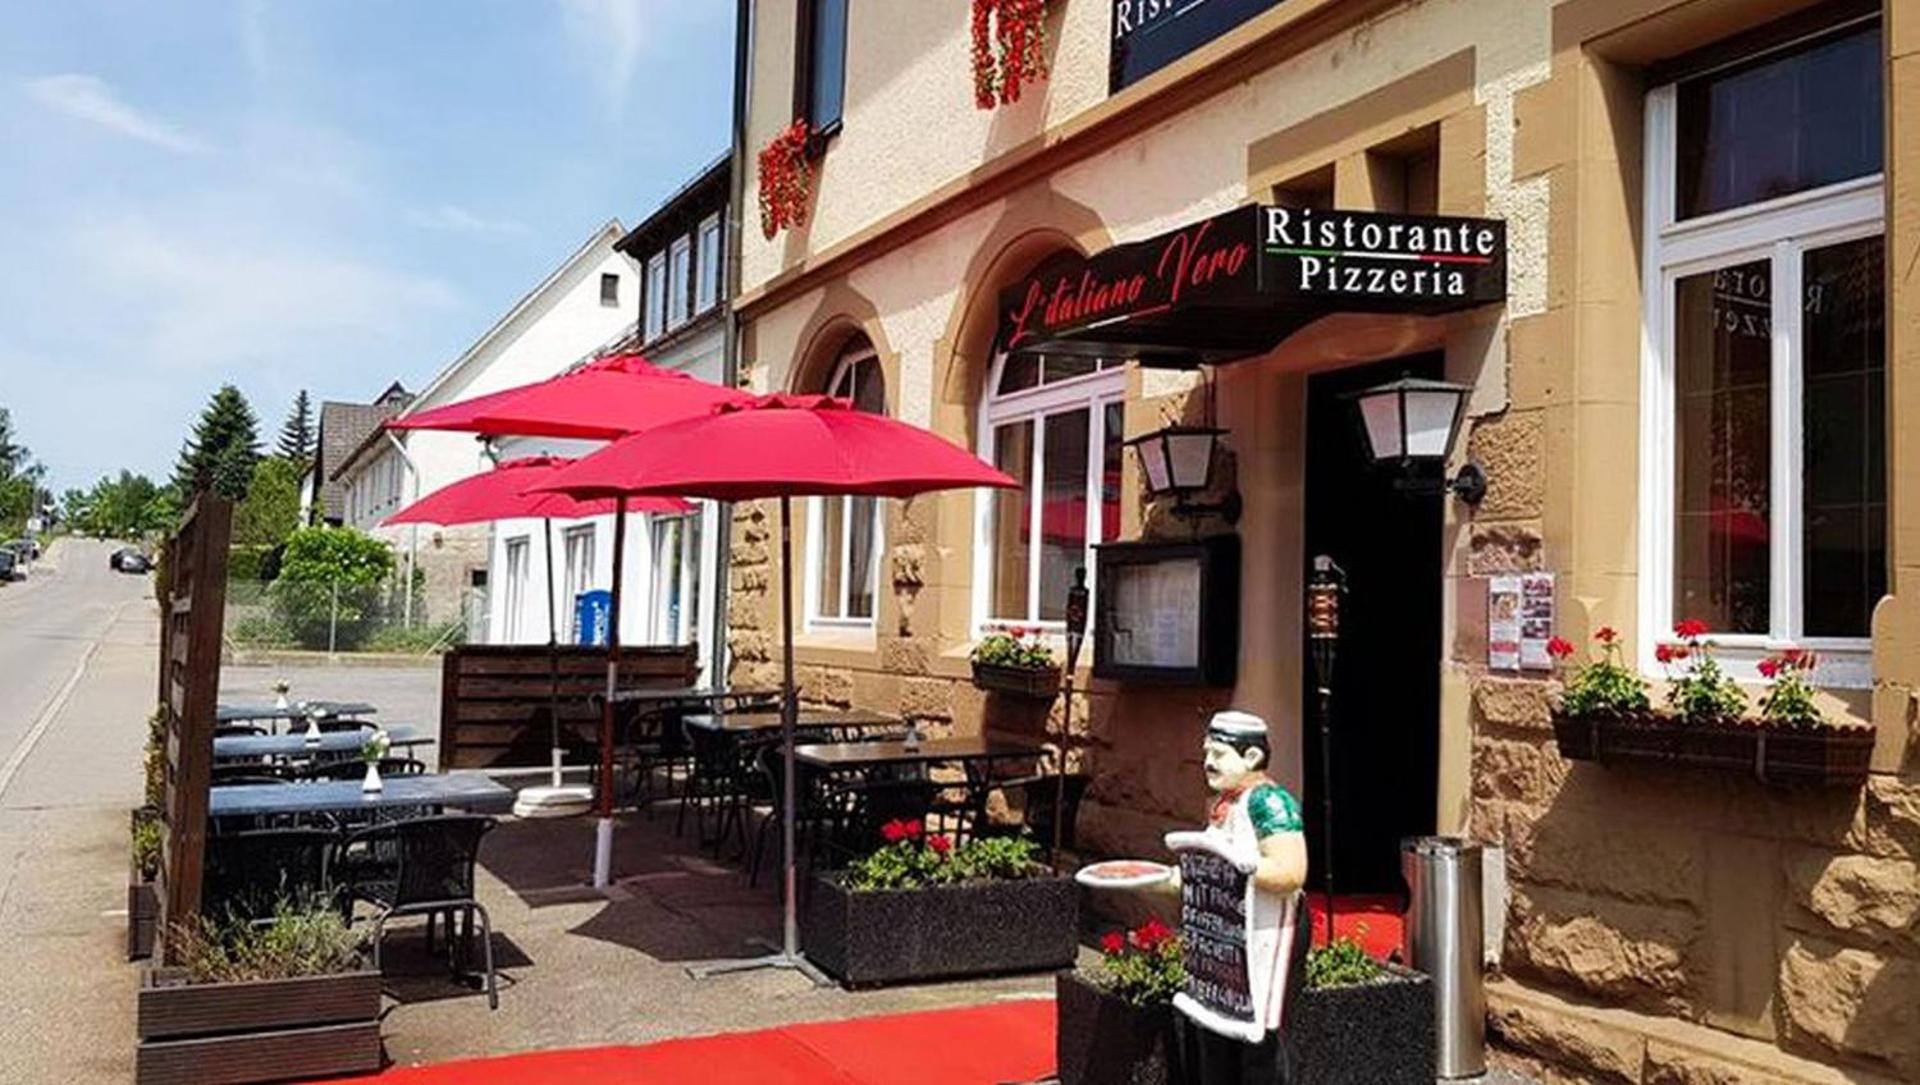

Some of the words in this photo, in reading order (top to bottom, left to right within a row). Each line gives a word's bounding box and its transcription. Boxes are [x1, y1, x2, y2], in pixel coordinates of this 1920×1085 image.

[1266, 207, 1495, 256] Ristorante
[1156, 219, 1250, 302] Vero
[1300, 255, 1465, 296] Pizzeria
